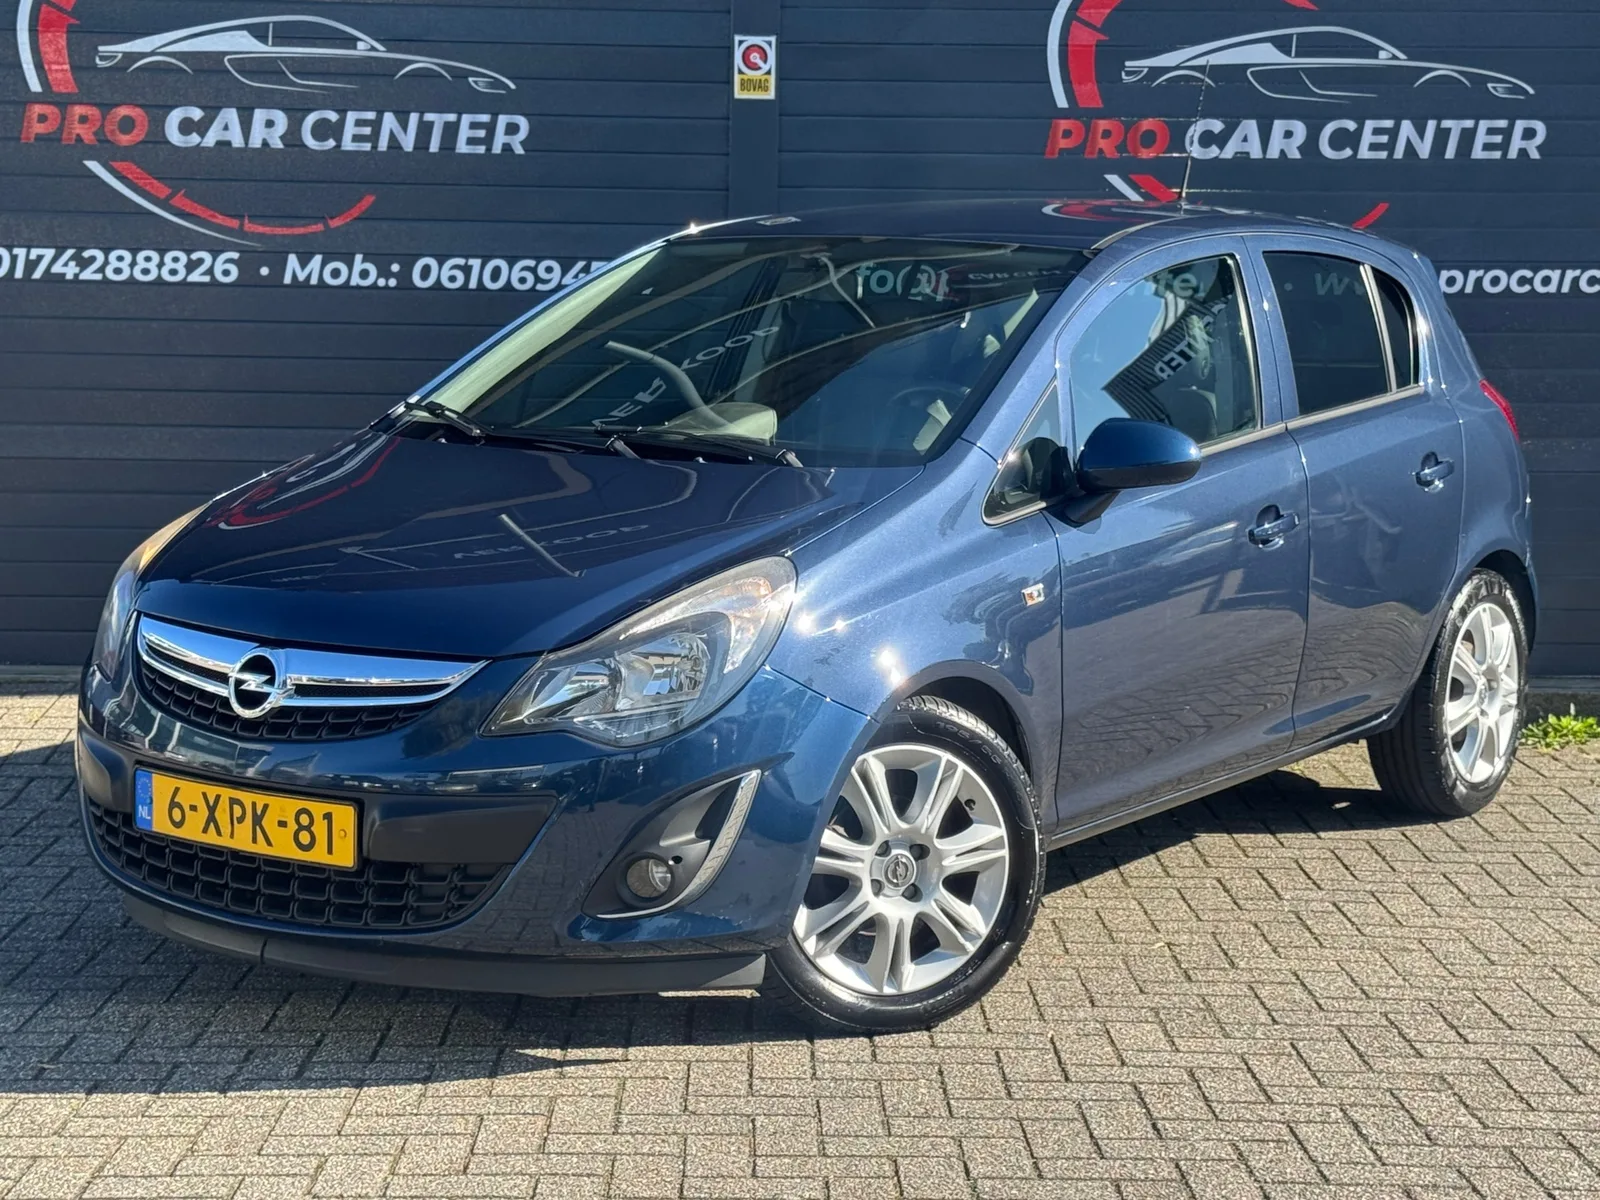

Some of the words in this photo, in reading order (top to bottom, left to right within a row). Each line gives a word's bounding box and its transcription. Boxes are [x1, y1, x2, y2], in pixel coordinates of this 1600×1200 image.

[740, 78, 769, 93] BOVAG
[20, 103, 149, 146] PRO
[164, 106, 288, 149] CAR
[301, 110, 530, 155] CENTER
[1044, 119, 1170, 158] PRO
[1185, 119, 1307, 159] CAR
[1318, 118, 1548, 159] CENTER
[283, 253, 399, 288] Mob.:
[137, 804, 151, 820] NL
[167, 786, 334, 856] 6-XPK-81
